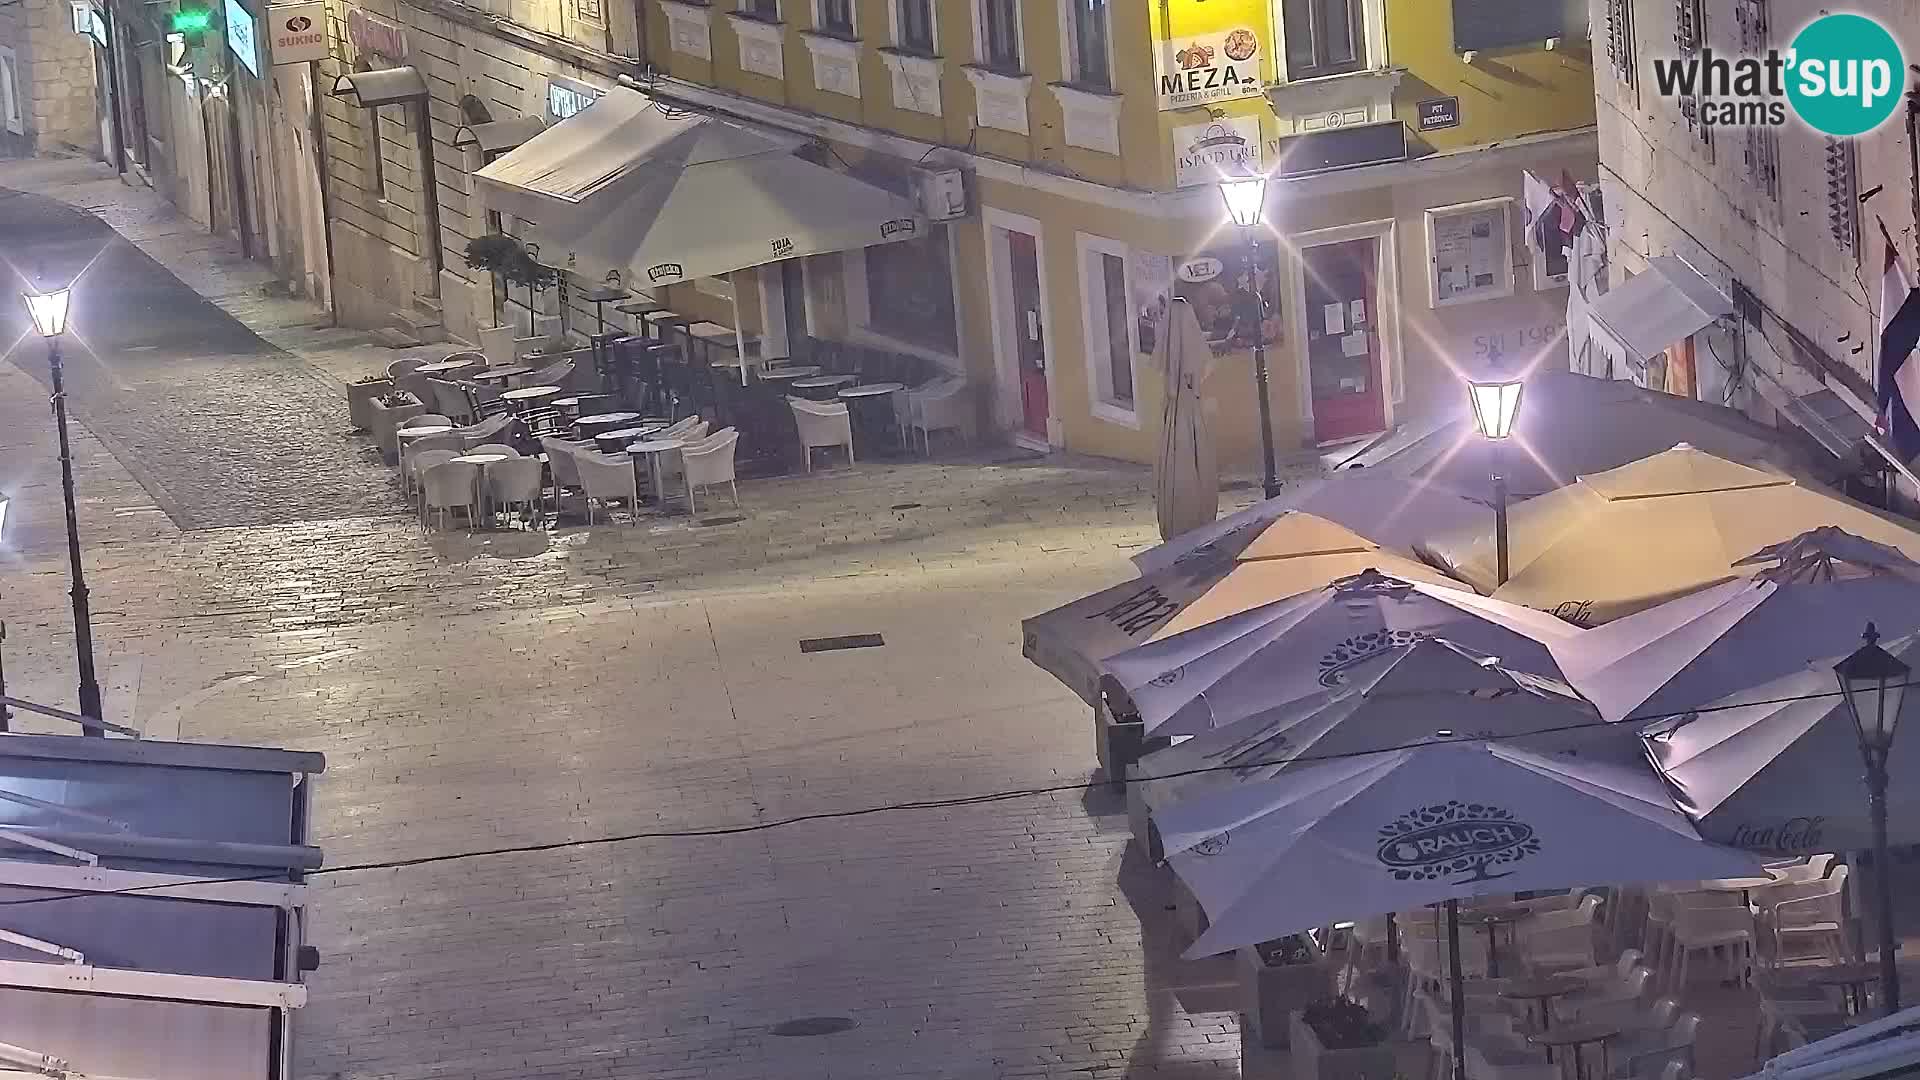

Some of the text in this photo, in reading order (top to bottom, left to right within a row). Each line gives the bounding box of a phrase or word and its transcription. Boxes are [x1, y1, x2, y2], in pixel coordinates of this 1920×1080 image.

[278, 34, 322, 47] SUKNO
[1161, 65, 1239, 95] MEZA
[1170, 91, 1202, 104] PIZZERIA
[1211, 87, 1232, 97] GRILL
[1180, 151, 1225, 169] ISPOD
[1417, 826, 1515, 854] RAUCH
